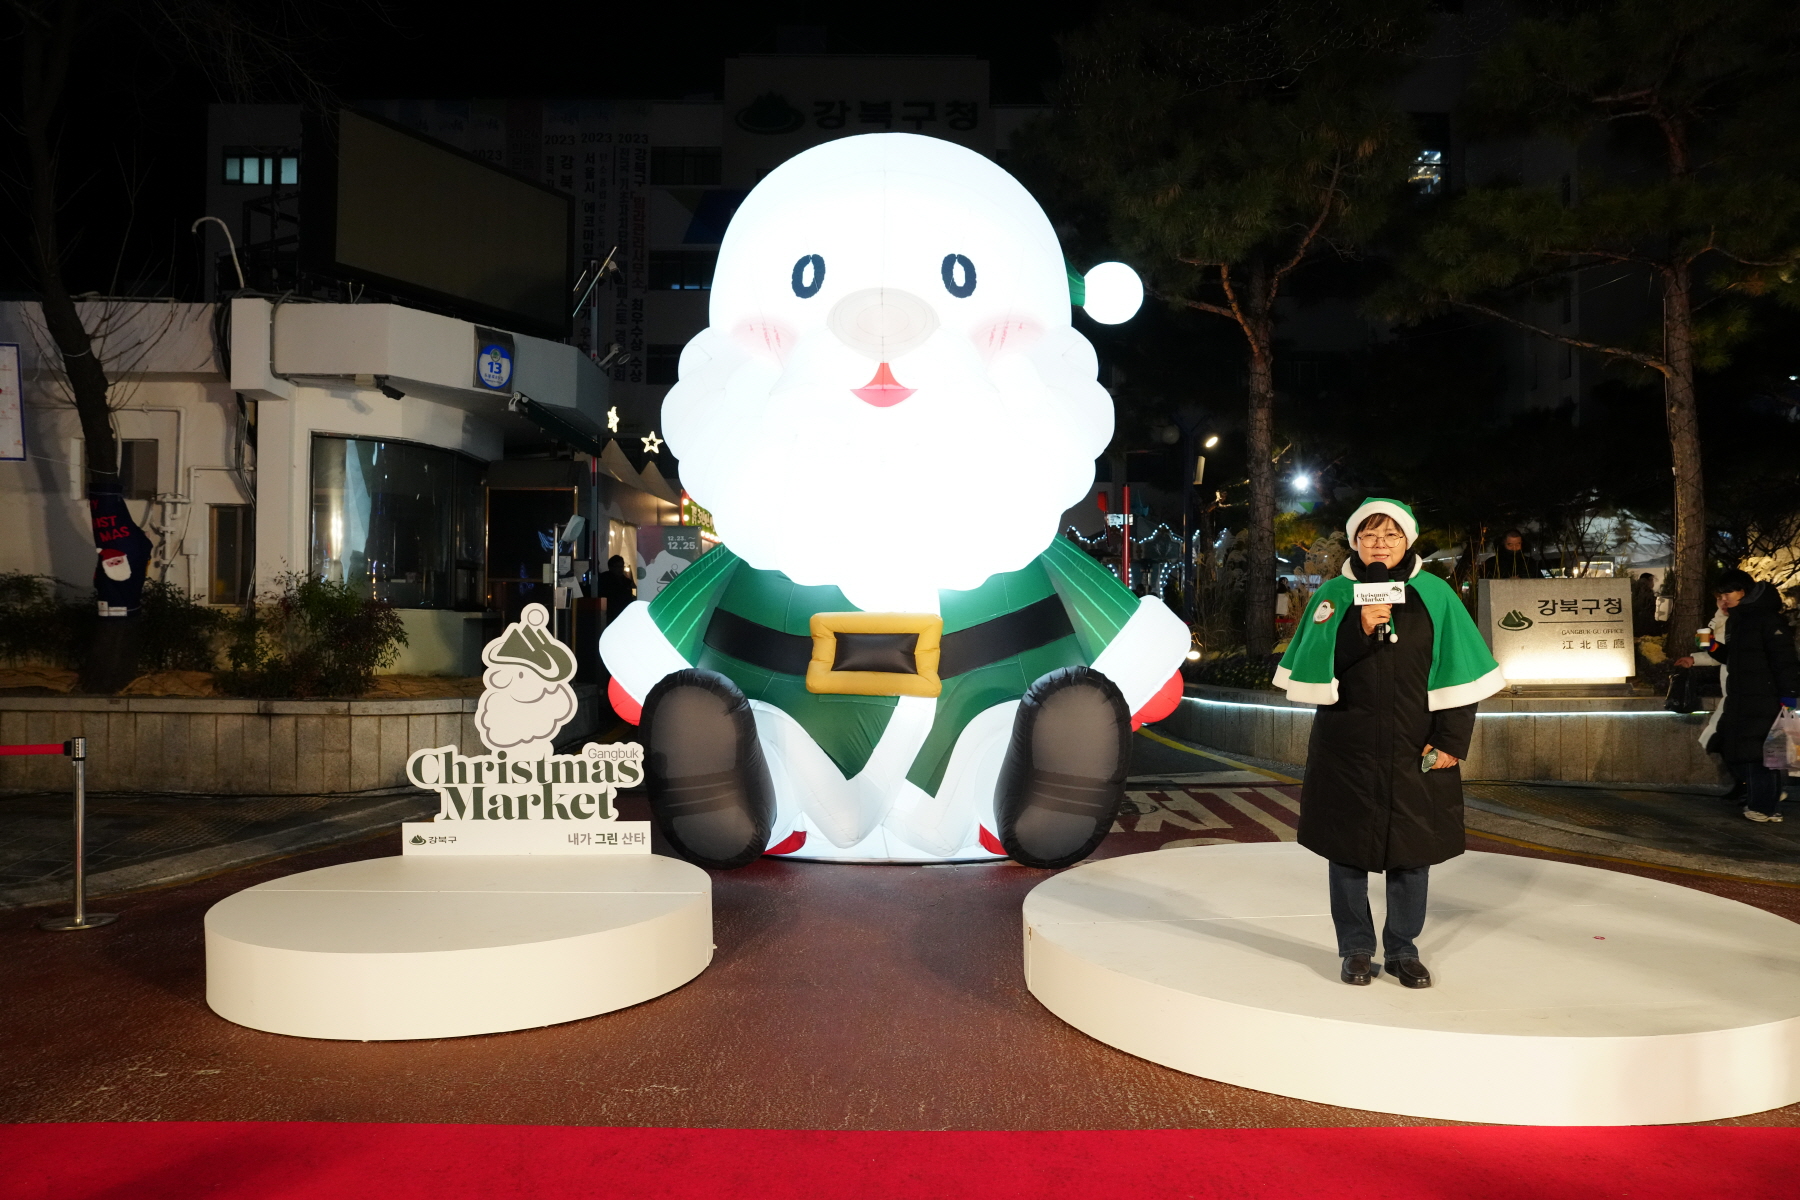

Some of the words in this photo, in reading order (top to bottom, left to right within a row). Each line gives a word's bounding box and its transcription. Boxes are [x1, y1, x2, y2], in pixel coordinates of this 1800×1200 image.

[813, 99, 978, 131] 강북구청
[544, 134, 576, 146] 2023
[581, 132, 613, 144] 2023
[618, 133, 649, 144] 2023
[584, 152, 596, 194] 서울시
[633, 147, 648, 188] 강북구
[629, 298, 644, 352] 최우수상
[487, 361, 502, 373] 13
[629, 356, 643, 383] 수상
[99, 525, 131, 542] MAS
[667, 541, 699, 550] 12.25.
[1537, 597, 1623, 616] 강북구청
[587, 747, 639, 762] Gangbuk
[411, 750, 640, 785] Christmas
[440, 781, 617, 821] Market
[428, 835, 457, 845] 강북구
[567, 832, 592, 846] 내가
[594, 832, 618, 846] 그린
[621, 832, 646, 846] 산타
